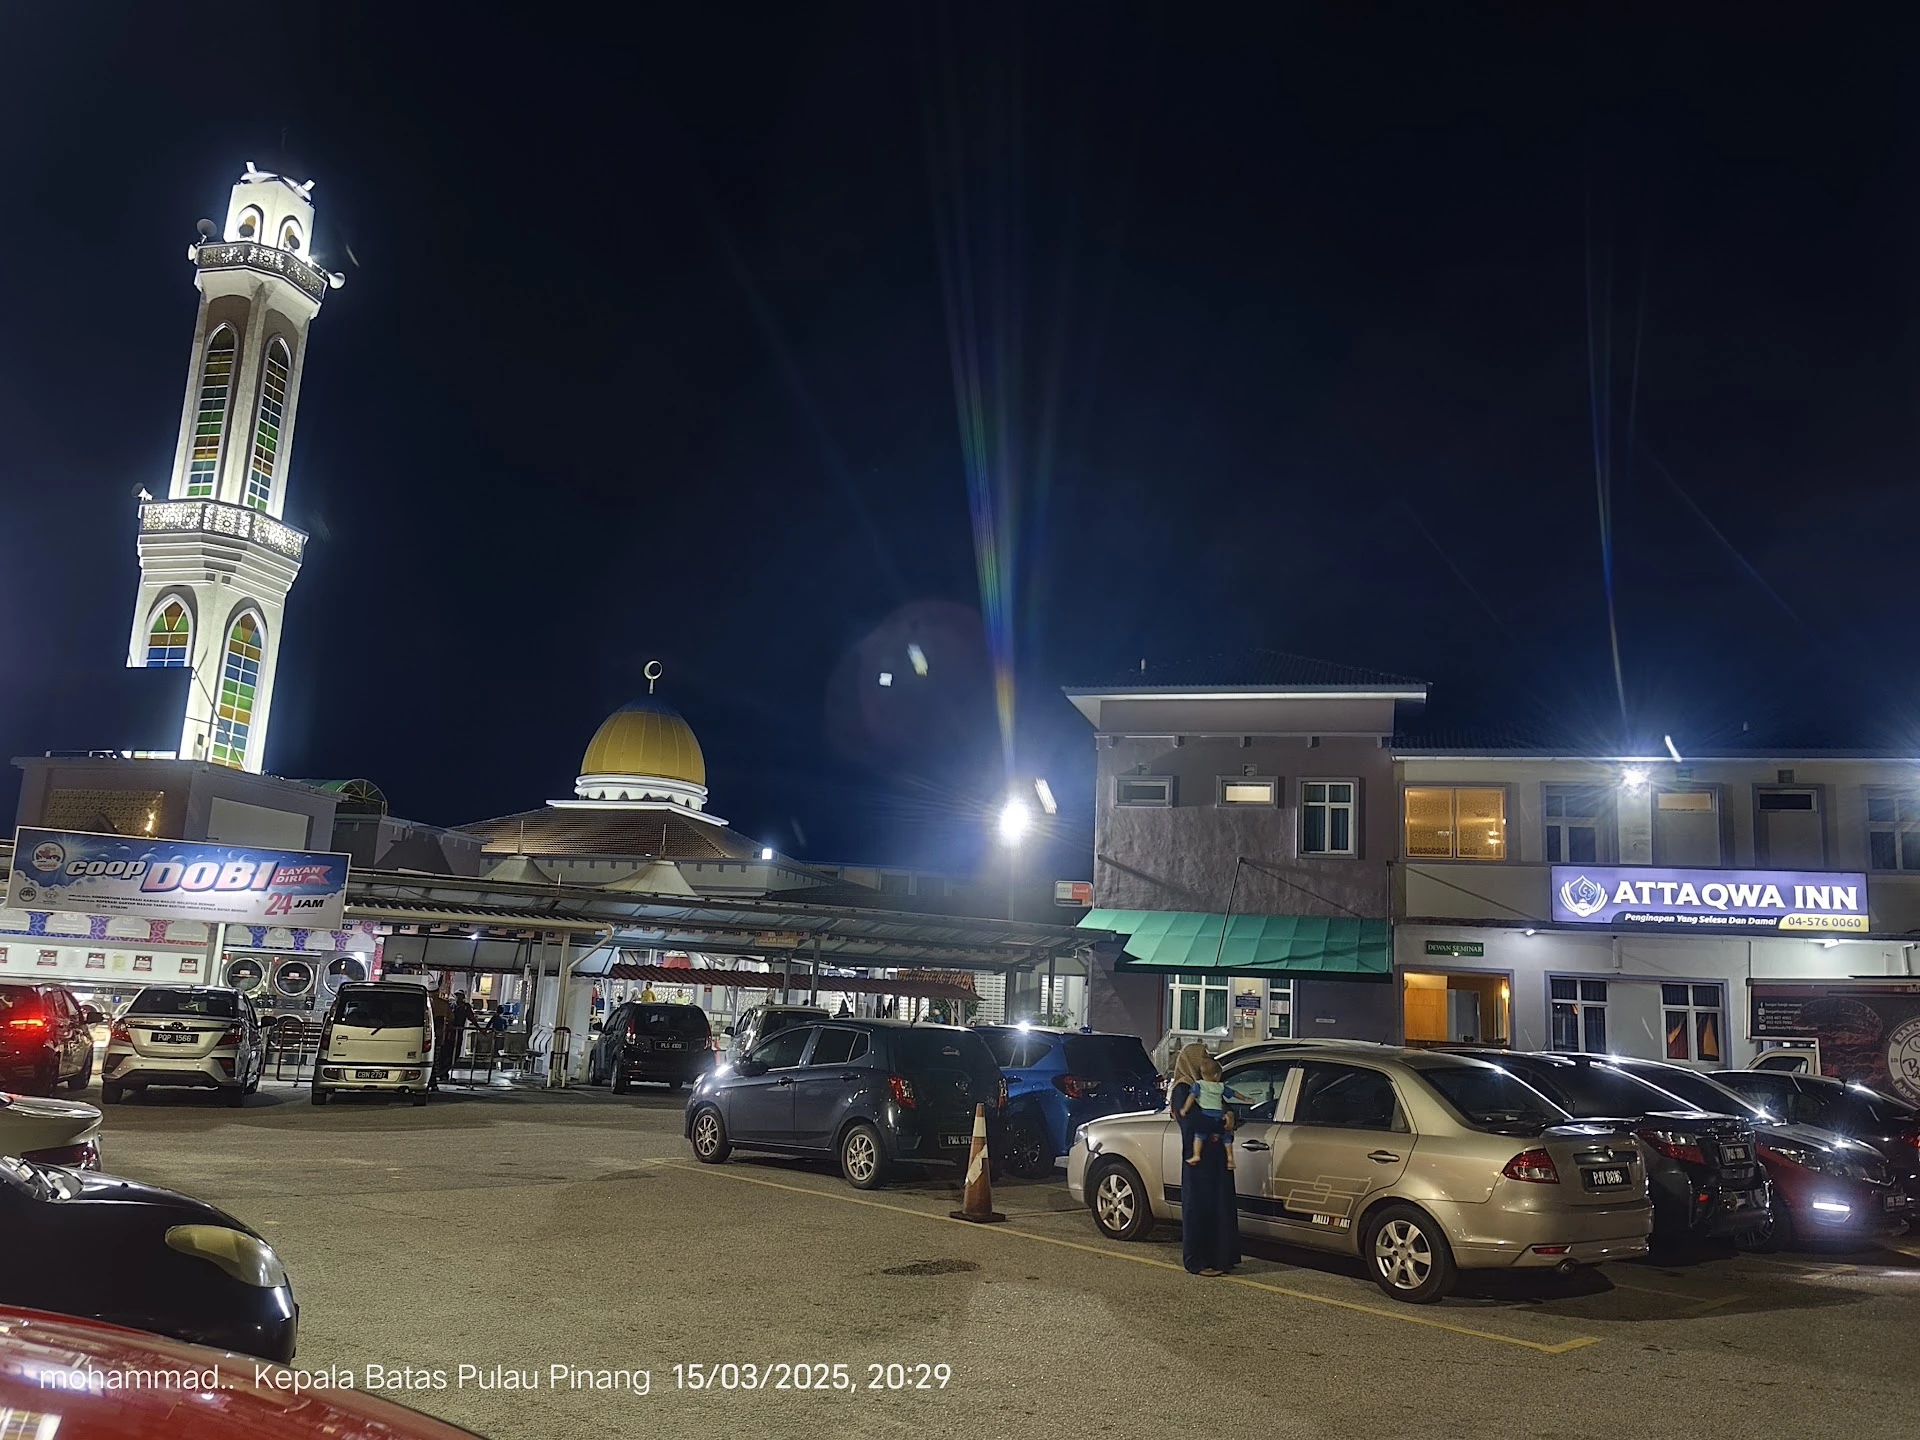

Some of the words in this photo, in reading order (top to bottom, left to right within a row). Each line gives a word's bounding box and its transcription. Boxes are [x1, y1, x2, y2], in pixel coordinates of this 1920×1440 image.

[66, 861, 147, 880] coop
[140, 860, 279, 892] DOBI
[278, 866, 321, 876] LAYAN
[275, 875, 303, 884] DIRI
[1612, 880, 1787, 910] ATTAQWA
[1793, 885, 1858, 910] INN
[264, 892, 293, 915] 24
[293, 899, 324, 908] JAM
[1624, 912, 1675, 924] Penginapan
[1676, 914, 1698, 925] Yang
[1698, 915, 1727, 924] Selesa
[1728, 916, 1747, 924] Dan
[1748, 917, 1778, 925] Damai
[1788, 916, 1828, 927] 04-576
[1831, 917, 1861, 928] 0060
[1452, 945, 1483, 953] SEMINAR
[157, 1034, 172, 1042] PQP
[175, 1034, 192, 1042] 1566
